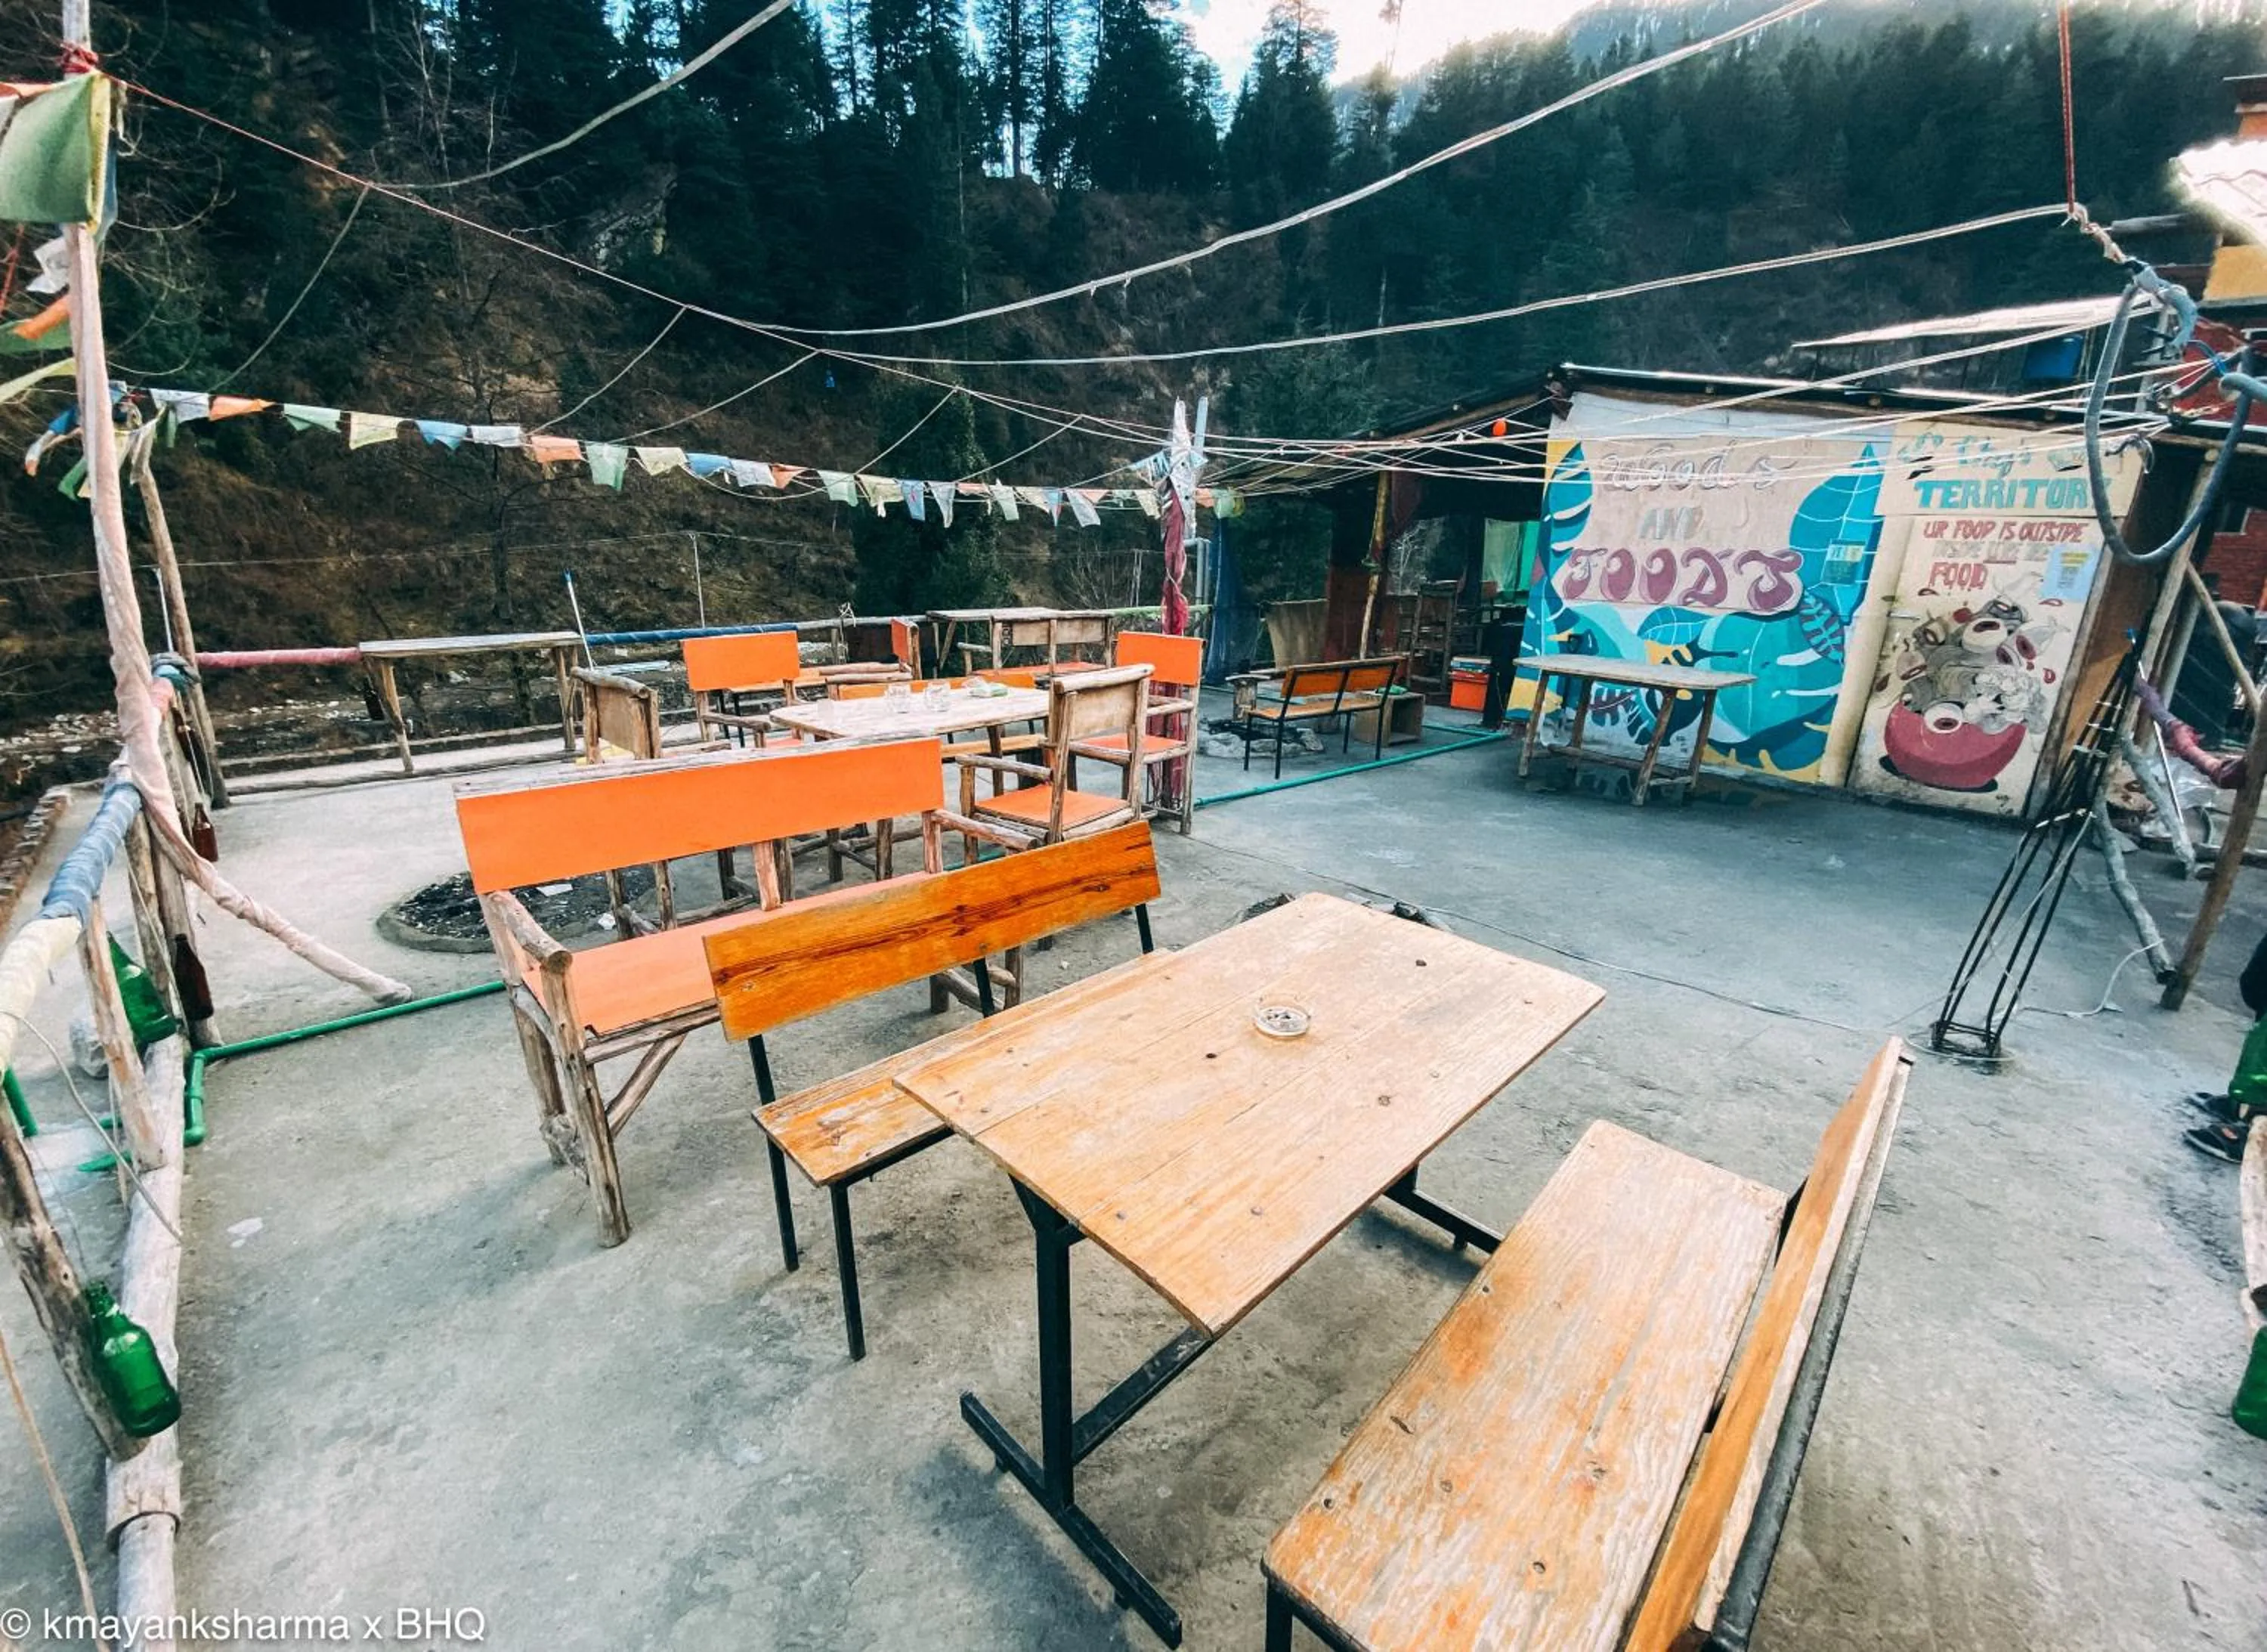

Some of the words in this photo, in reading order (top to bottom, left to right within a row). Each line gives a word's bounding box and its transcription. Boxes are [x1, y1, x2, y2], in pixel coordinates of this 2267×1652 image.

[1913, 477, 2112, 509] TERRITOR
[1999, 521, 2017, 540] IS
[1928, 561, 1988, 591] FOOD
